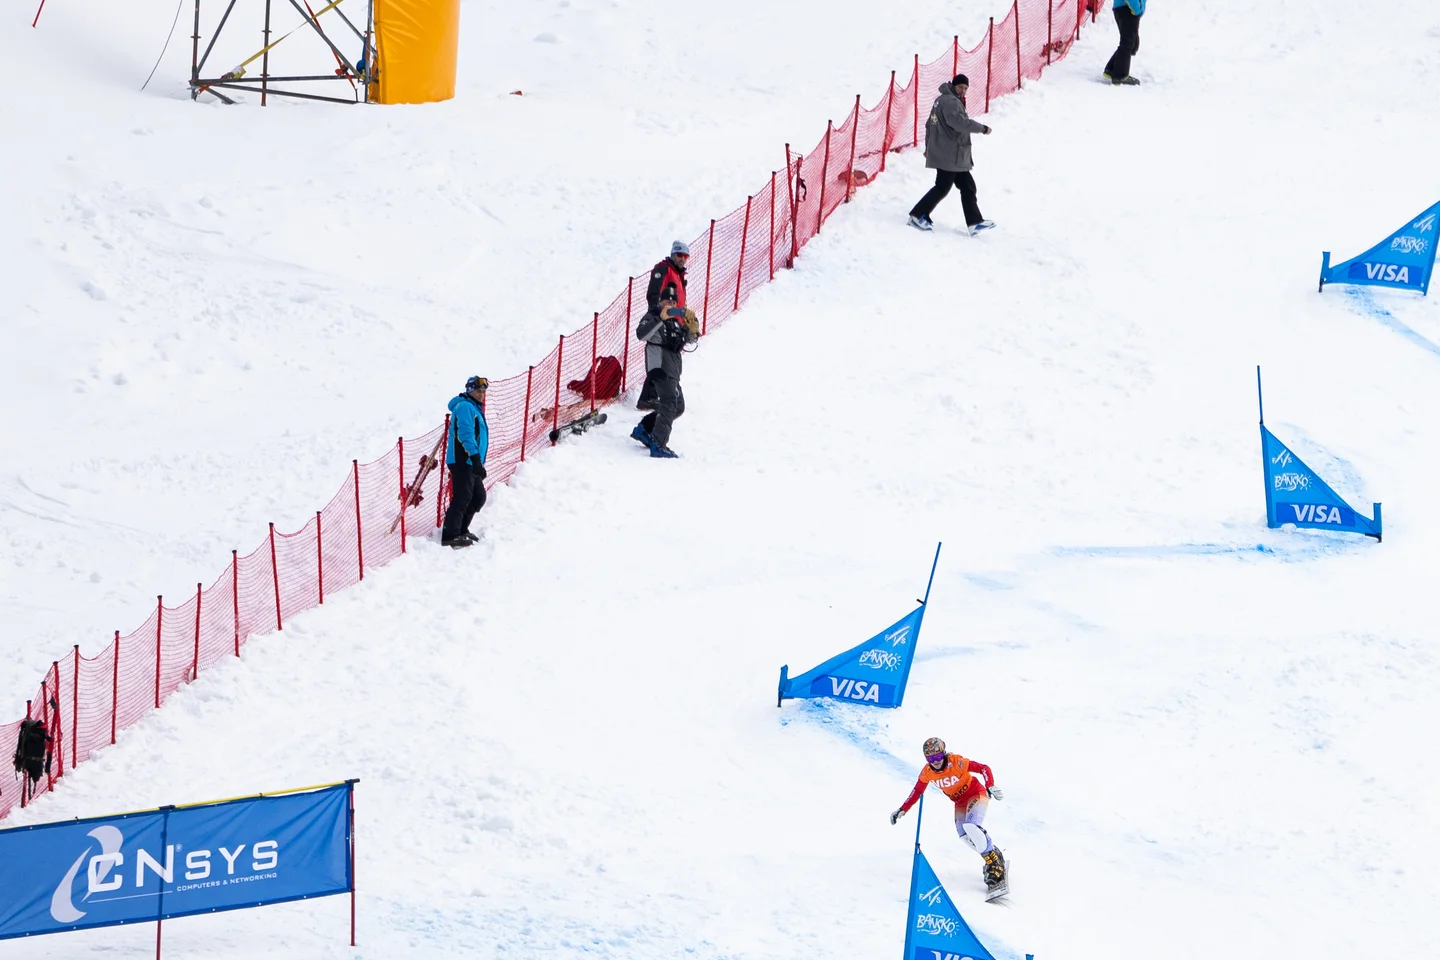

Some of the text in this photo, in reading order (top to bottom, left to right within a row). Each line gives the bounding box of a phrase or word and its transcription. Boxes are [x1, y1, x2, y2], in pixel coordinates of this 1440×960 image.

[1364, 262, 1410, 284] VISA
[1291, 504, 1342, 525] VISA
[828, 676, 879, 703] VISA
[930, 776, 960, 788] VISA
[176, 879, 221, 892] COMPUTERS
[230, 872, 278, 884] NETWORKING
